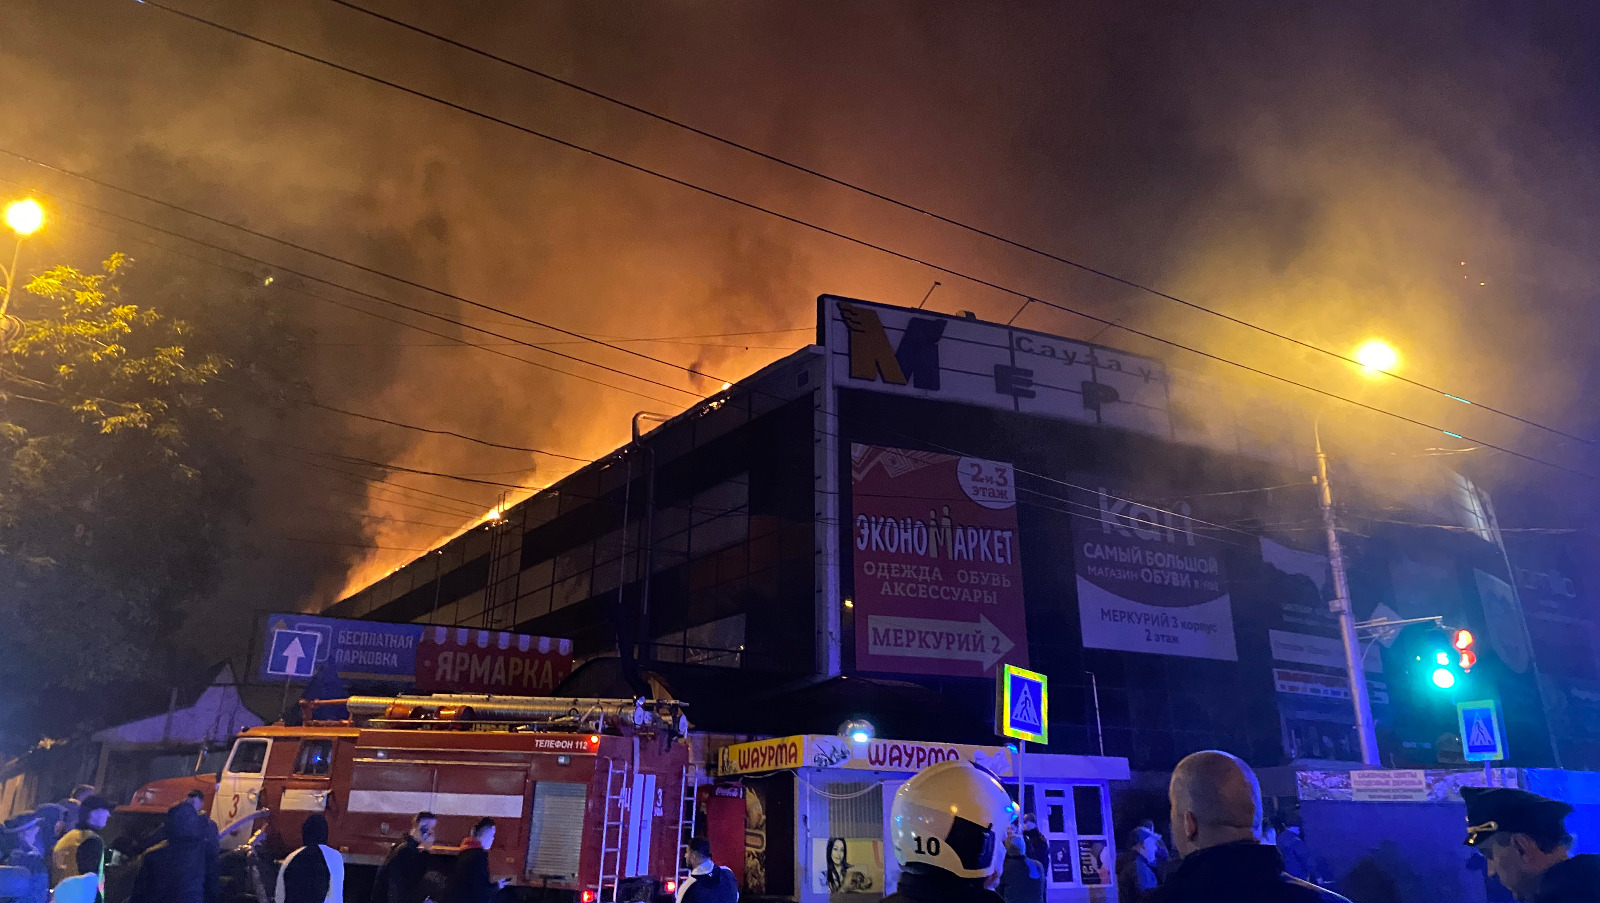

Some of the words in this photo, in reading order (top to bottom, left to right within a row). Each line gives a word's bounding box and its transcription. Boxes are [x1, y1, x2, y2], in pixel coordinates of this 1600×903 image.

[972, 485, 1008, 500] этаж
[1099, 486, 1195, 546] kari
[856, 505, 1013, 565] ЭКОНОМАРКЕТ
[1083, 542, 1142, 565] САМЫЙ
[1145, 551, 1218, 575] БОЛЬШОЙ
[863, 561, 943, 582] ОДЕЖДА
[957, 570, 1012, 588] ОБУВЬ
[1087, 565, 1138, 581] МАГАЗИН
[1141, 568, 1191, 588] ОБУВИ
[880, 581, 998, 605] АКСЕССУАРЫ
[1100, 608, 1169, 628] МЕРКУРИЙ
[1172, 616, 1179, 628] 3
[1180, 621, 1217, 634] корпус
[338, 630, 413, 649] БЕСПЛАТНАЯ
[872, 627, 986, 653] МЕРКУРИЙ
[991, 636, 1000, 653] 2
[1145, 629, 1152, 641] 2
[1154, 633, 1179, 644] этаж
[335, 649, 398, 668] ПАРКОВКА
[435, 651, 554, 689] ЯРМАРКА
[535, 740, 573, 749] ТЕЛЕФОН
[575, 741, 588, 750] 112
[738, 741, 798, 770] ШАУРМА
[229, 794, 240, 818] 3
[914, 836, 941, 857] 10
